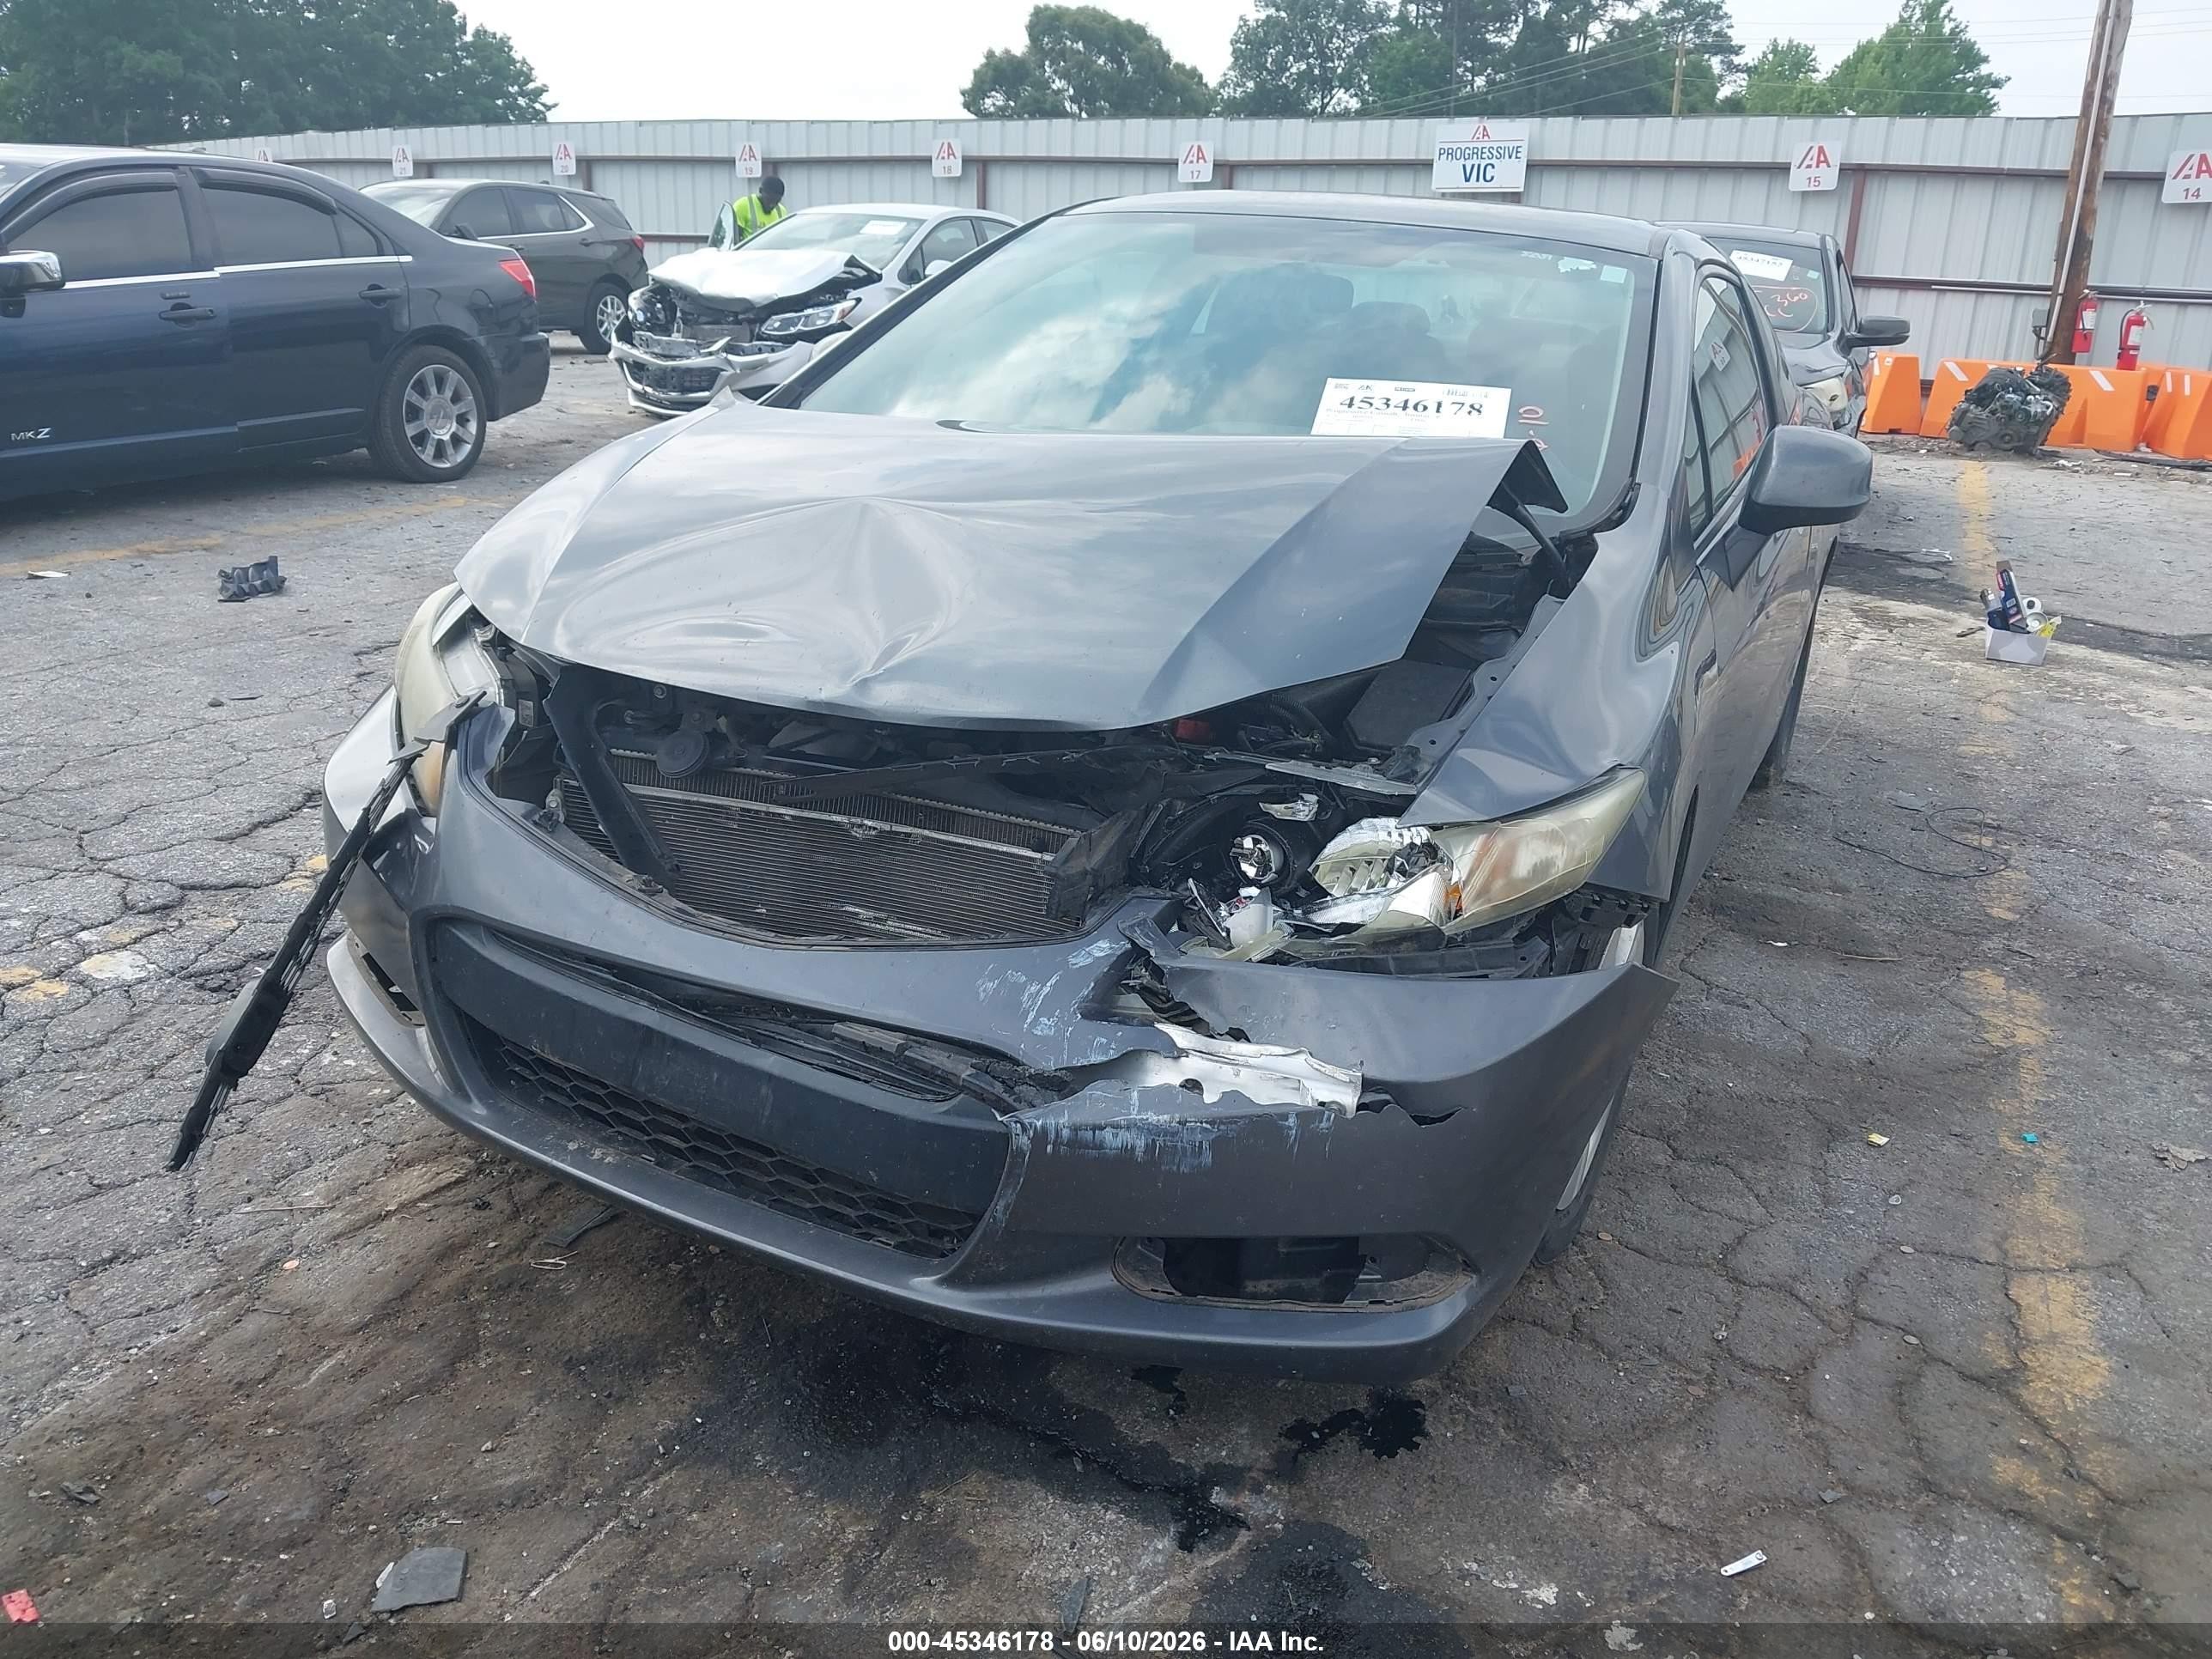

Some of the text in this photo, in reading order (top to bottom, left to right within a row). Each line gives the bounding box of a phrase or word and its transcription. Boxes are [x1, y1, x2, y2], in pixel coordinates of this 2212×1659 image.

[1437, 145, 1522, 161] PROGRESSIVE
[1190, 170, 1201, 179] 17
[1462, 163, 1495, 183] VIC
[1806, 176, 1821, 188] 15
[2183, 187, 2202, 200] 14
[1339, 395, 1484, 416] 45346178
[10, 427, 52, 441] MKZ
